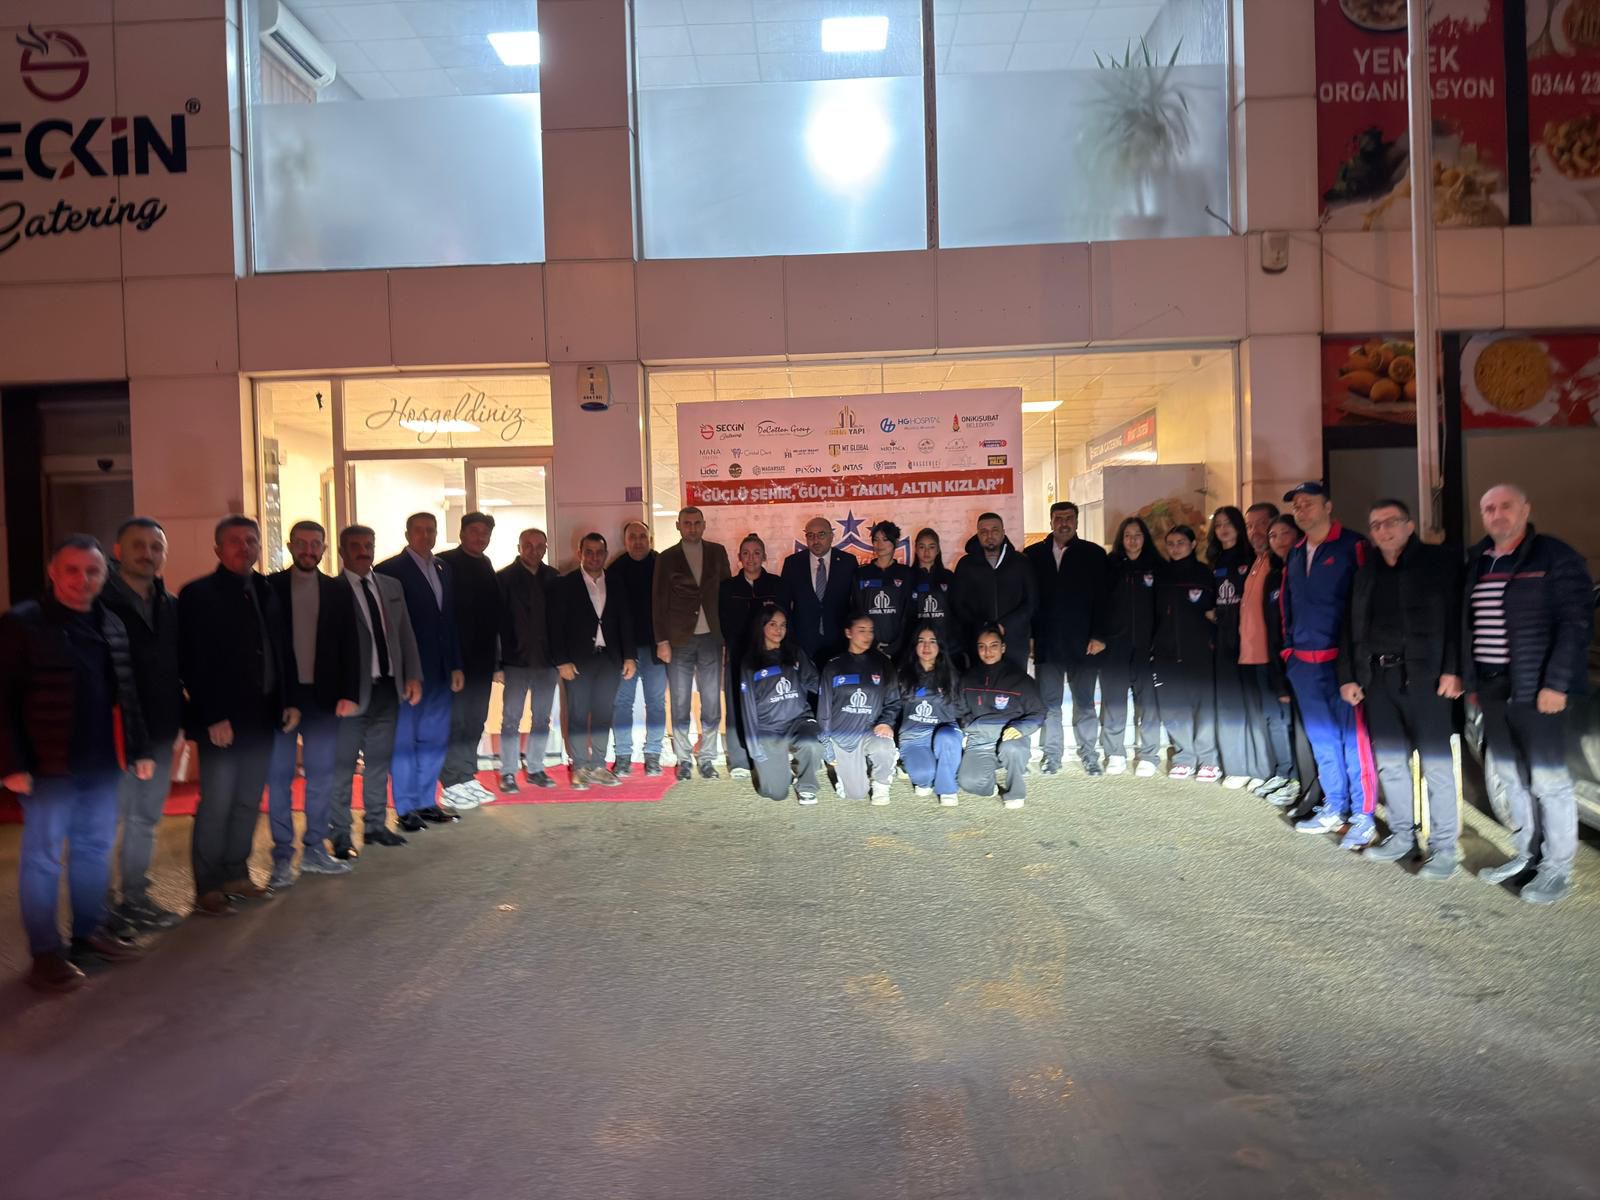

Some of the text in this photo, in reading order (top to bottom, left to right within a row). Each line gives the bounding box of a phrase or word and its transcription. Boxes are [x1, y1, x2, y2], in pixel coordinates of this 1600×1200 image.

[1319, 76, 1495, 103] ORGANİSYON
[1532, 71, 1575, 96] 0344
[851, 482, 899, 497] TAKIM,
[901, 480, 943, 495] ALTIN
